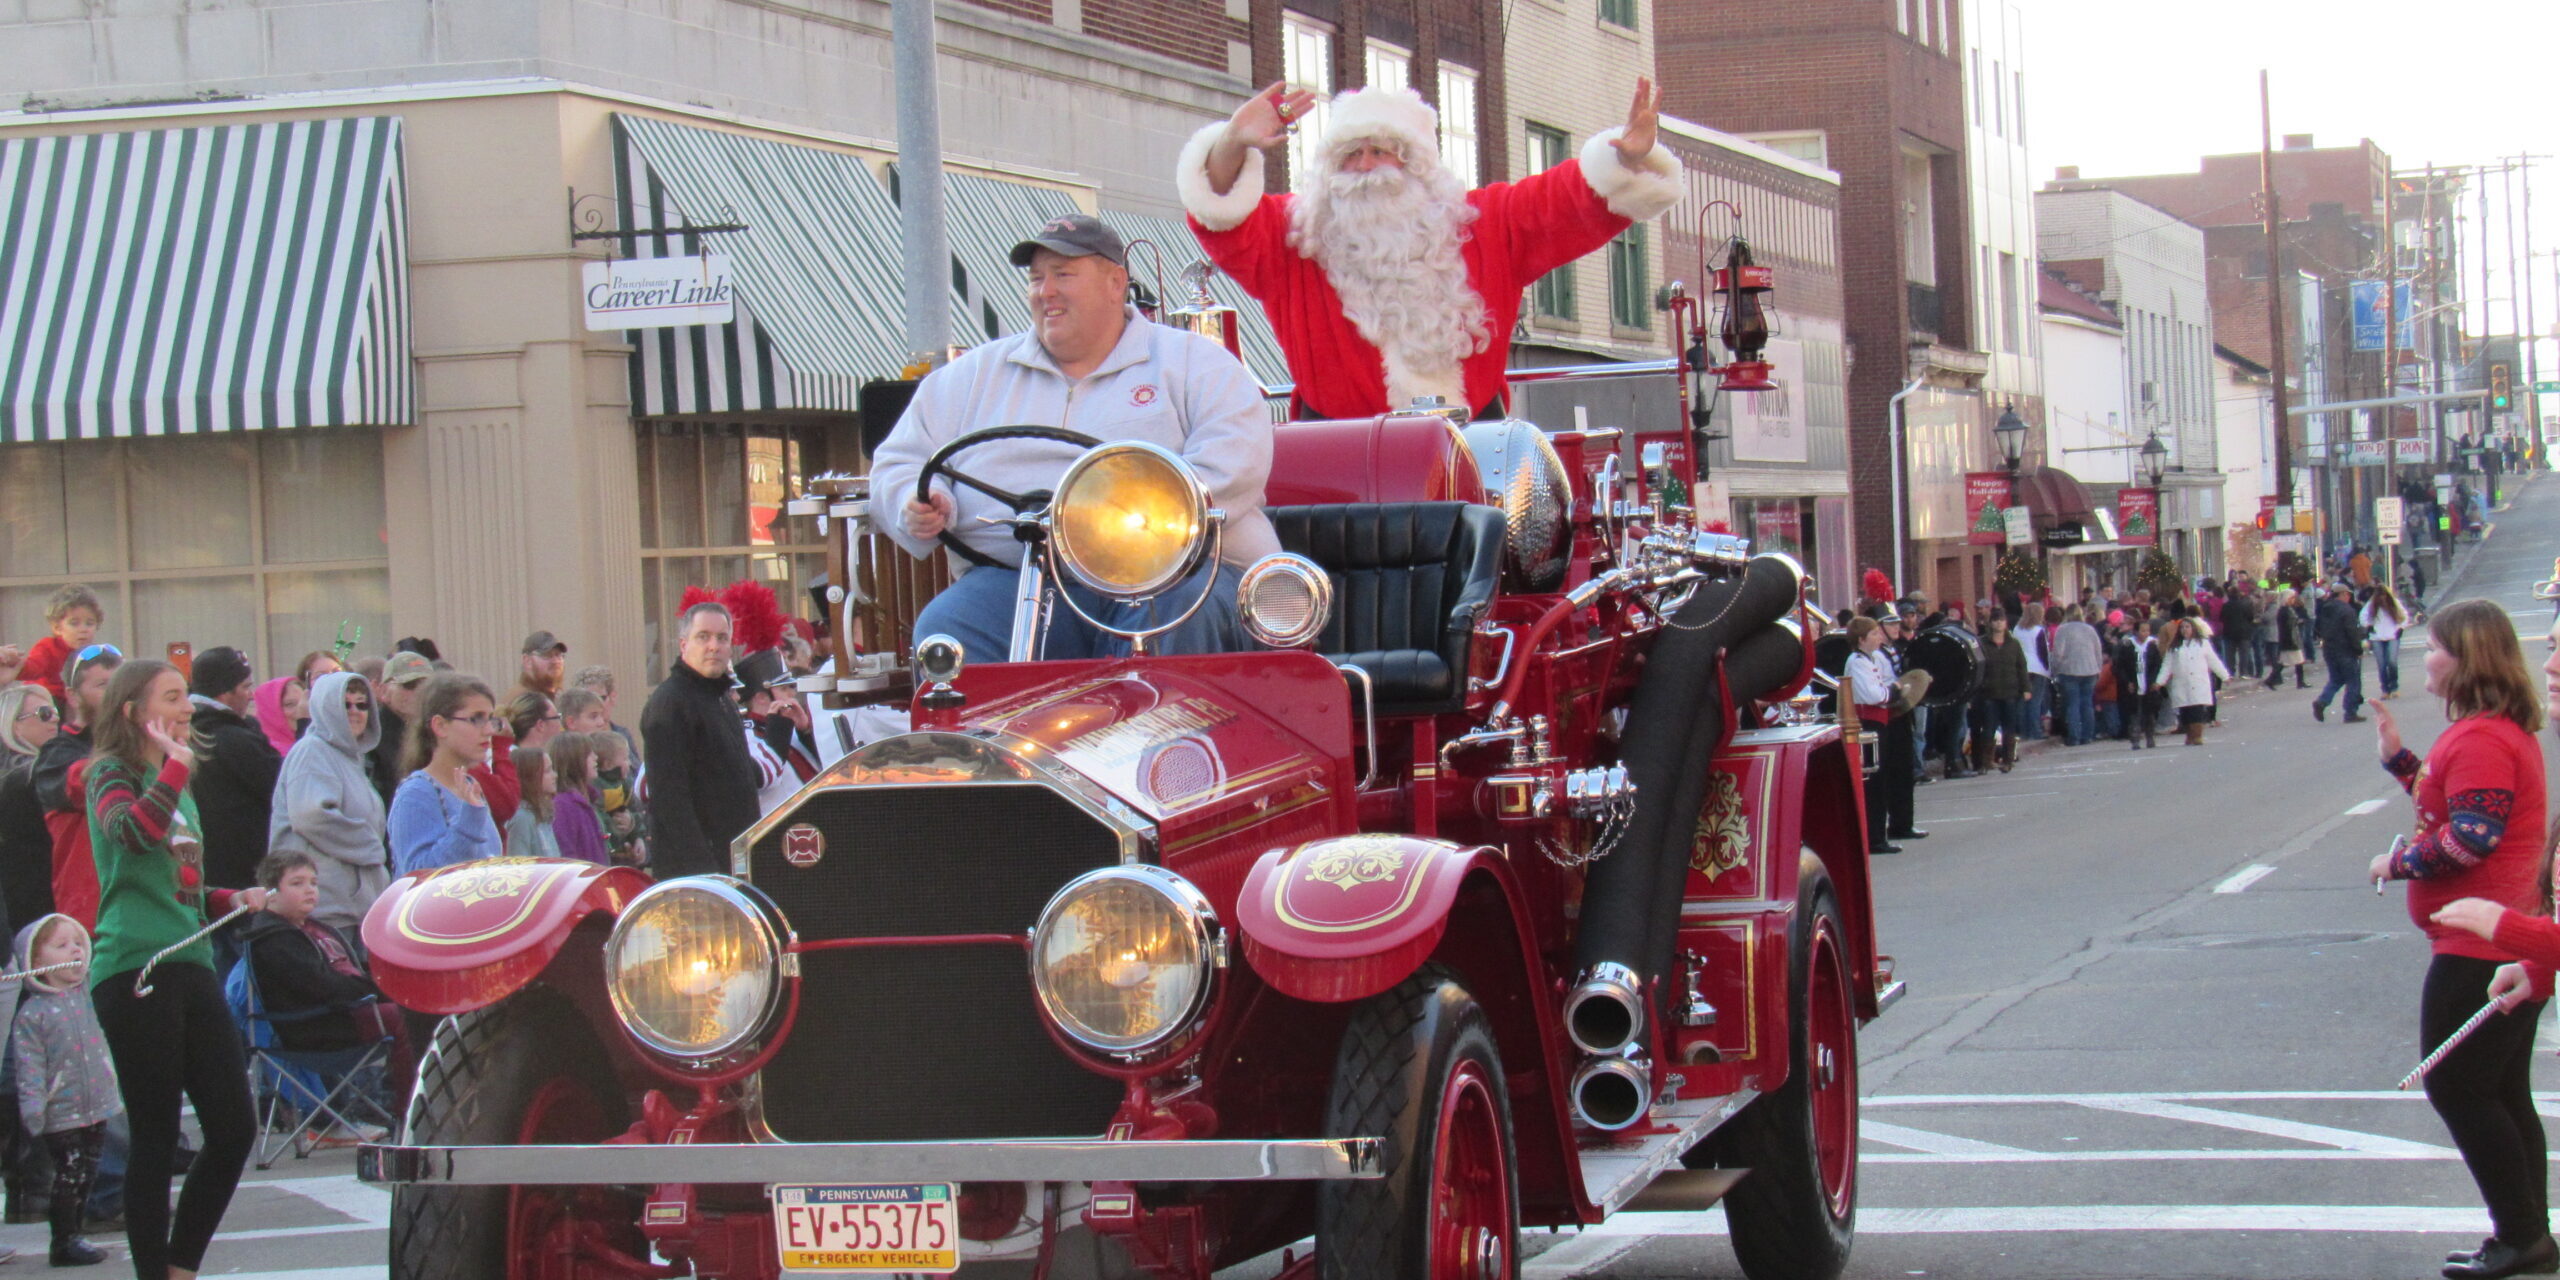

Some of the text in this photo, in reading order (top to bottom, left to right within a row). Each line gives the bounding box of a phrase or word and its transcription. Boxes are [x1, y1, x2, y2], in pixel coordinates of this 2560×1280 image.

[613, 276, 669, 290] Pennsylvania
[1972, 480, 2002, 488] Happy
[1968, 487, 2008, 495] Holidays
[819, 1189, 908, 1201] PENNSYLVANIA
[799, 1252, 940, 1265] EMERGENCY VEHICLE
